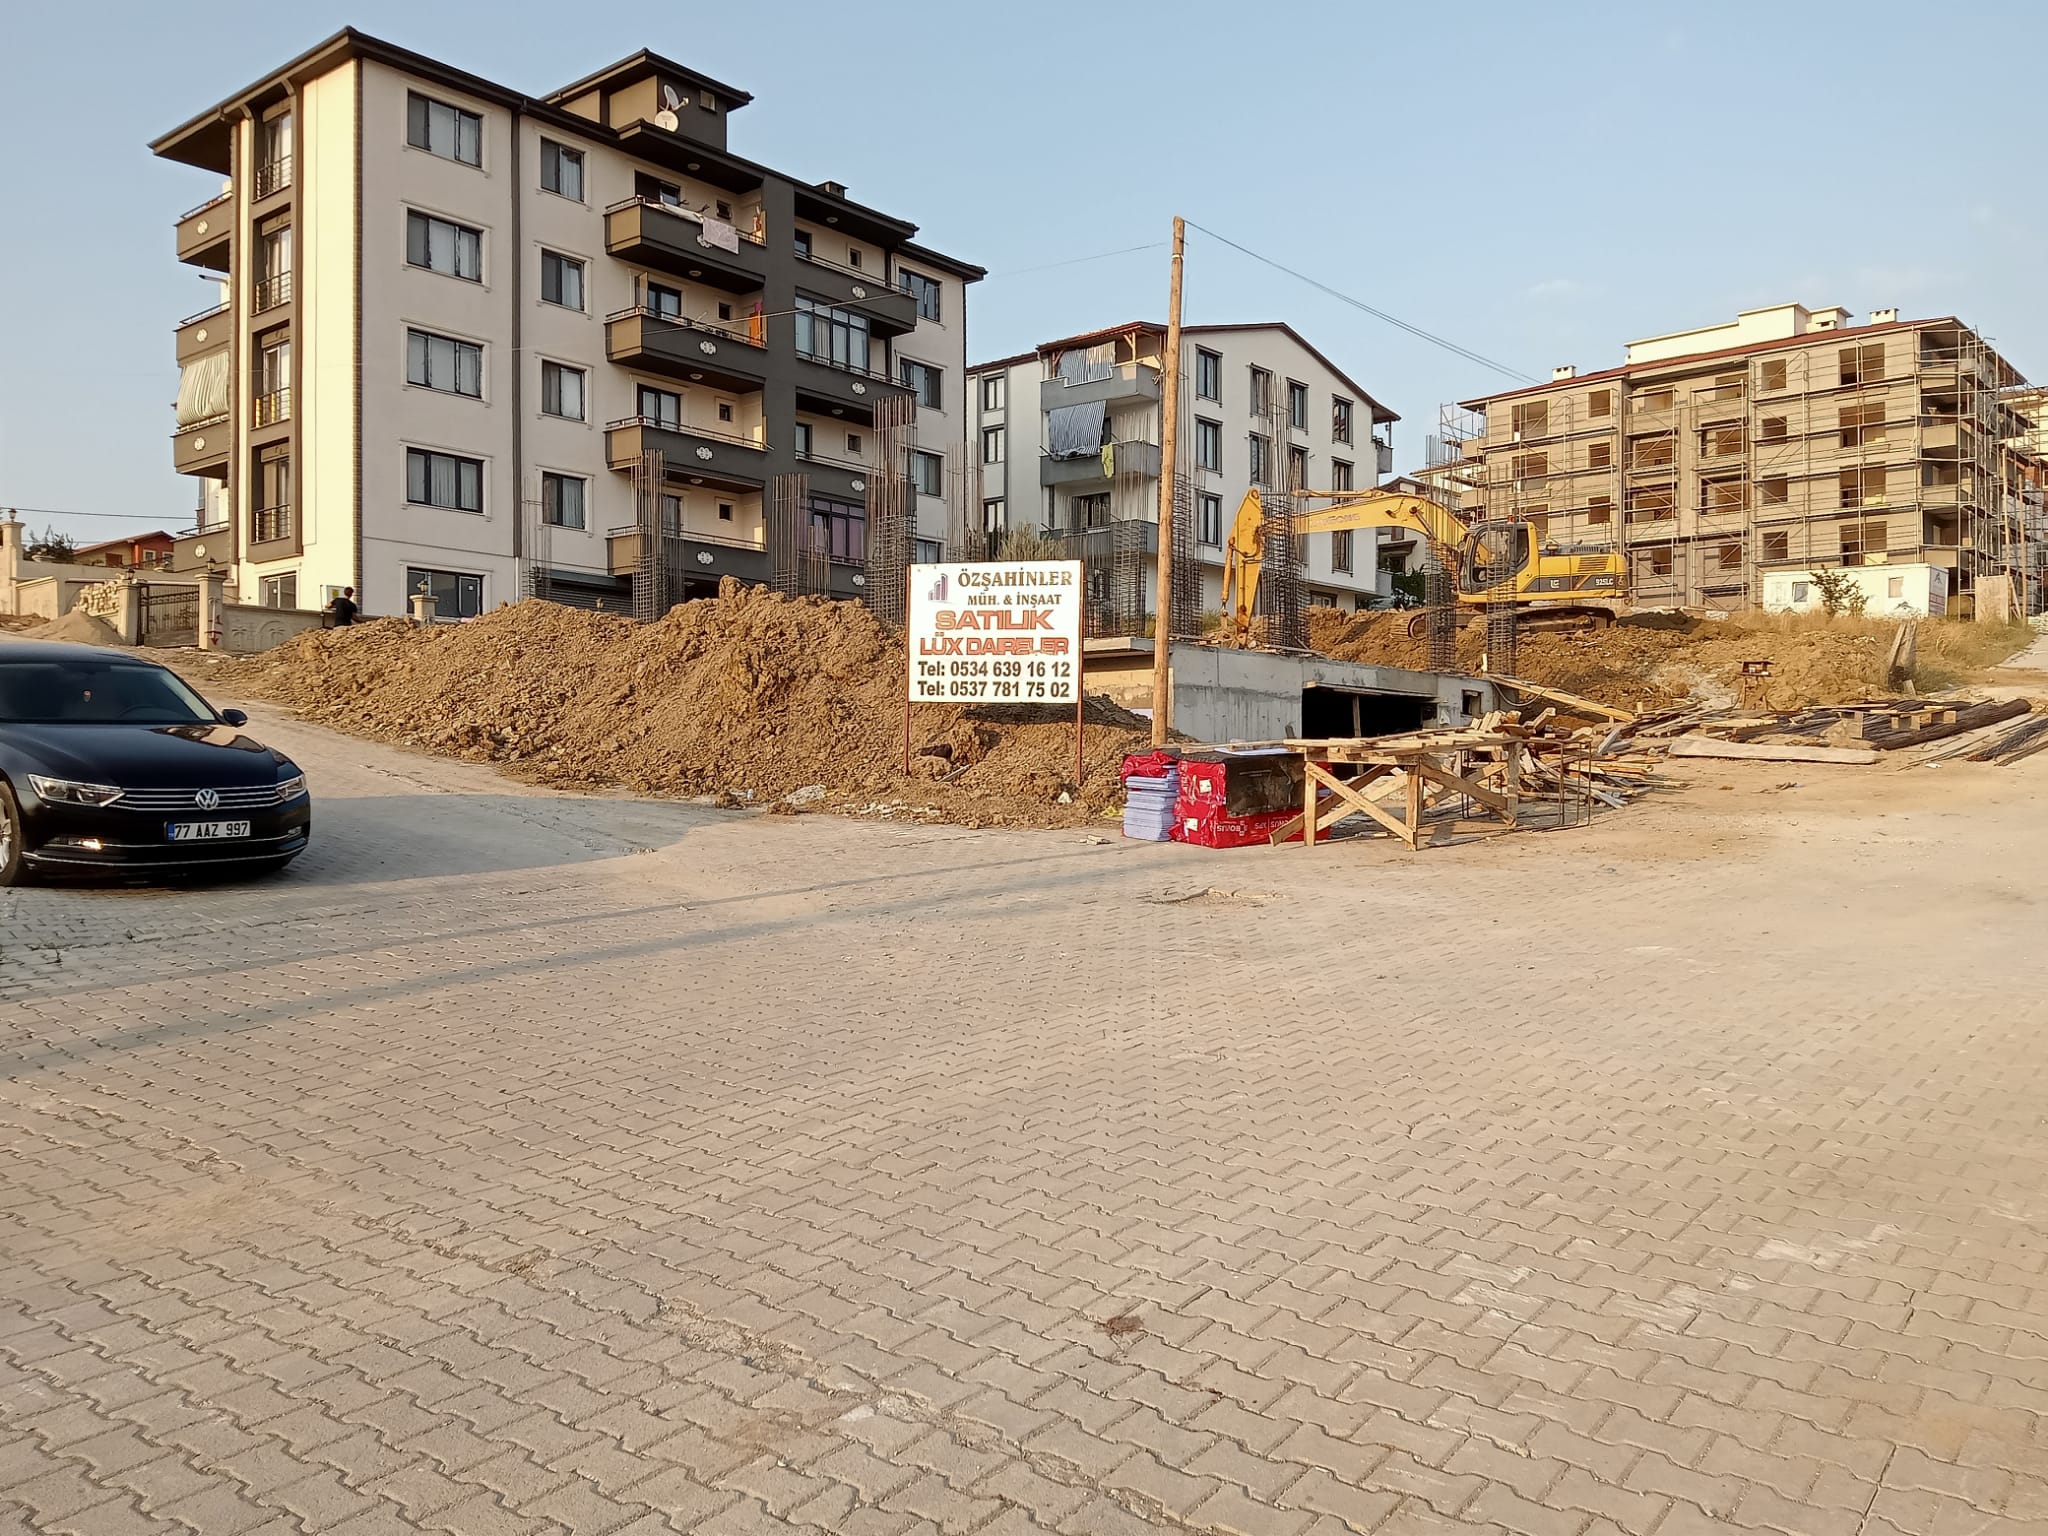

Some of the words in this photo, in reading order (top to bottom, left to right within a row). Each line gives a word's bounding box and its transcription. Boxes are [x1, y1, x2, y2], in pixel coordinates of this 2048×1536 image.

[958, 567, 1072, 591] ÖZŞAHİNLER
[967, 593, 1000, 606] MÜH.
[1003, 595, 1013, 606] &
[1016, 592, 1062, 608] İNŞAAT
[935, 609, 1055, 630] SATILIK
[920, 632, 964, 656] LÜX
[918, 661, 945, 677] Tel:
[950, 661, 989, 677] 0534
[993, 661, 1021, 677] 639
[1027, 661, 1046, 678] 16
[1051, 661, 1070, 678] 12
[917, 681, 945, 696] Tel:
[950, 681, 988, 697] 0537
[993, 681, 1020, 697] 781
[1026, 682, 1045, 698] 75
[1050, 682, 1070, 698] 02
[175, 824, 190, 839] 77
[196, 824, 219, 837] AAZ
[226, 822, 249, 836] 997
